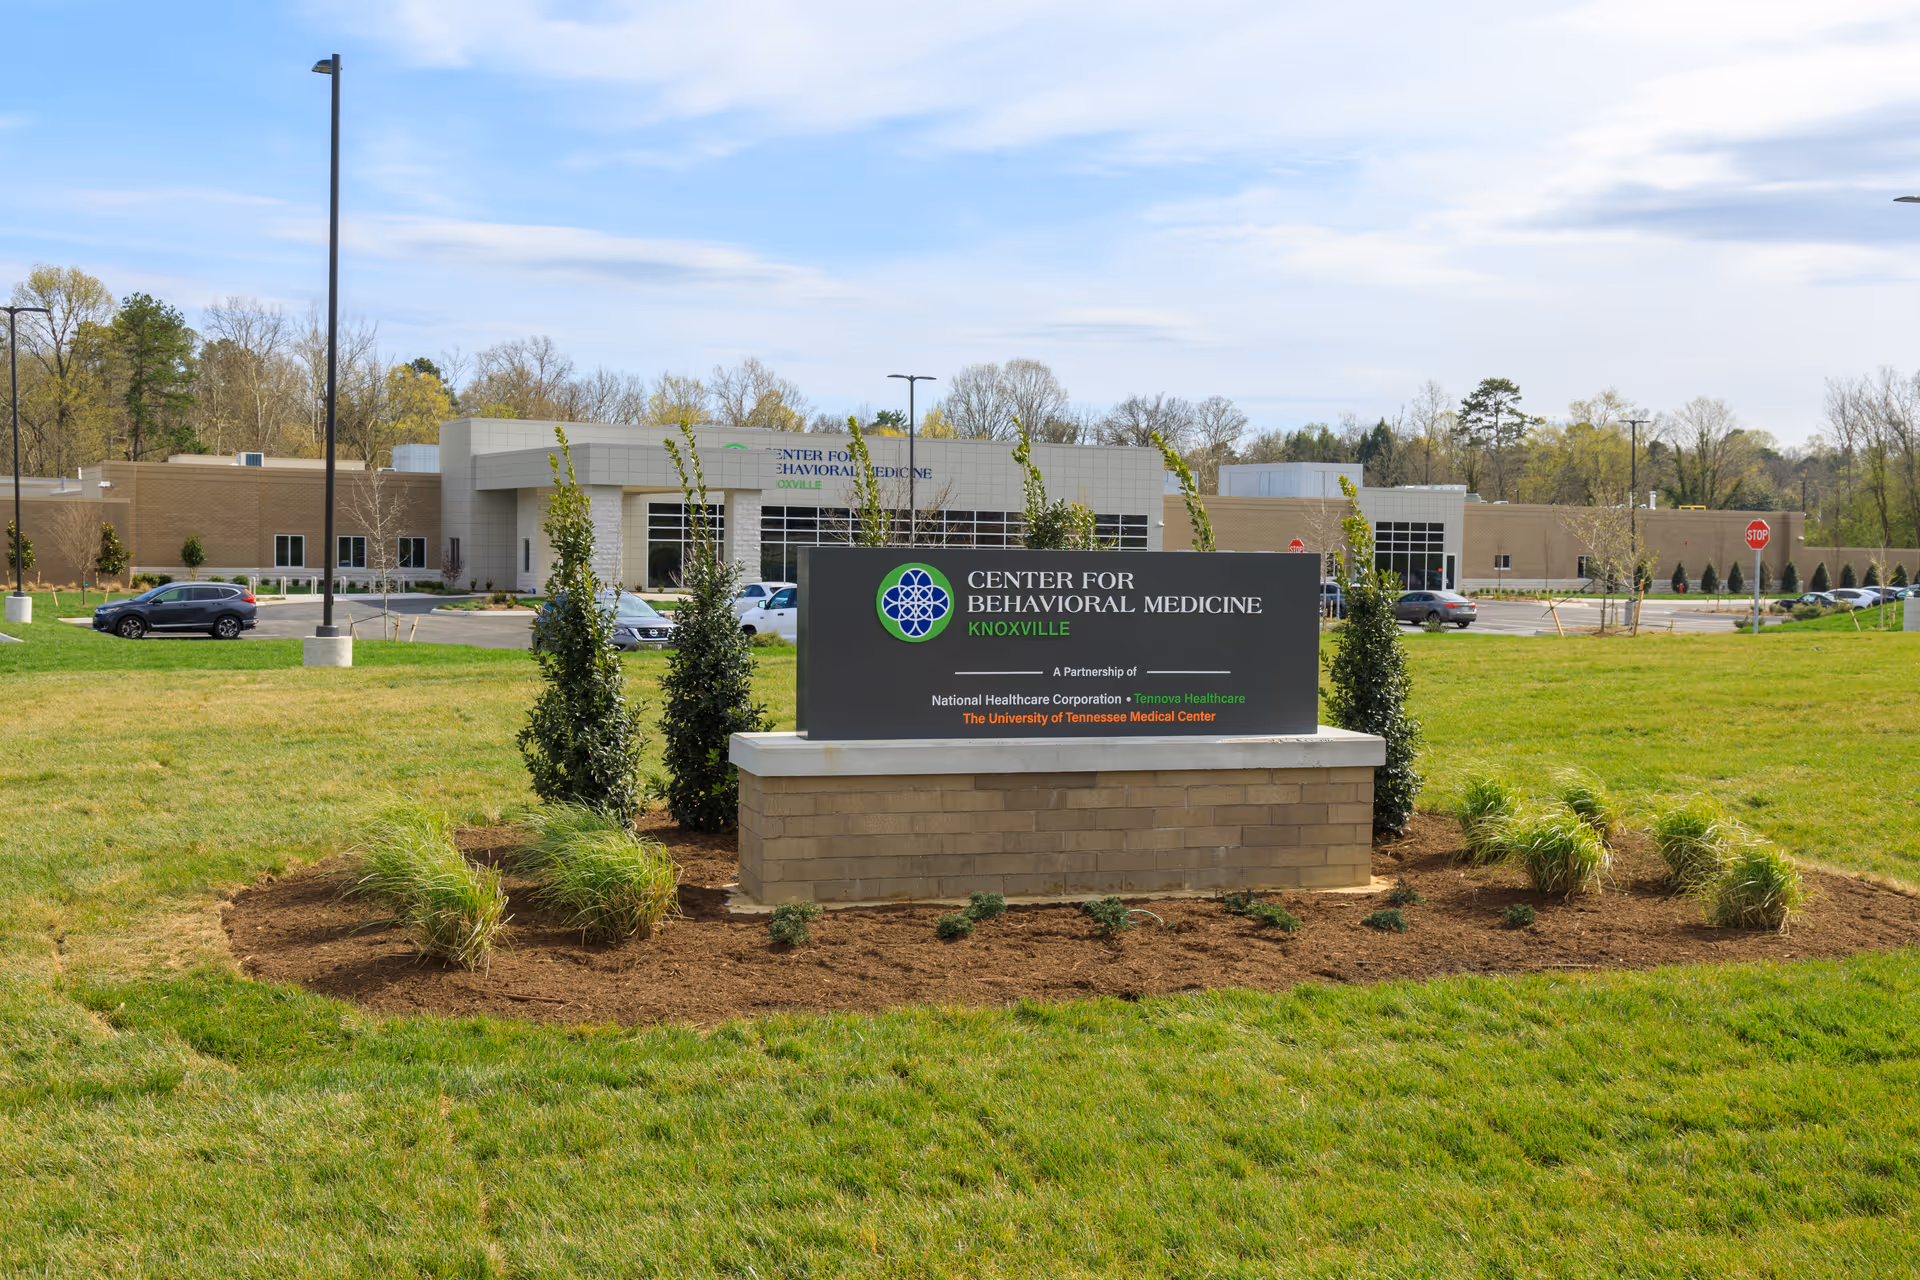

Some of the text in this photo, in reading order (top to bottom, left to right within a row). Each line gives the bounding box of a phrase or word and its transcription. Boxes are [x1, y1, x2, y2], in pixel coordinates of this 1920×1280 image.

[765, 448, 823, 461] ENTER
[776, 463, 858, 477] EHAVIORAL
[1747, 530, 1768, 541] STOP
[967, 571, 1135, 590] CENTER FOR
[967, 595, 1263, 615] BEHAVIORAL MEDICINE
[968, 621, 1071, 636] KNOXVILLE
[1053, 666, 1138, 679] A Partnership of
[932, 693, 1246, 708] National Healthcare Corporation Tennova Healthcare
[963, 711, 1217, 727] The University of Tennessee Medical Center
